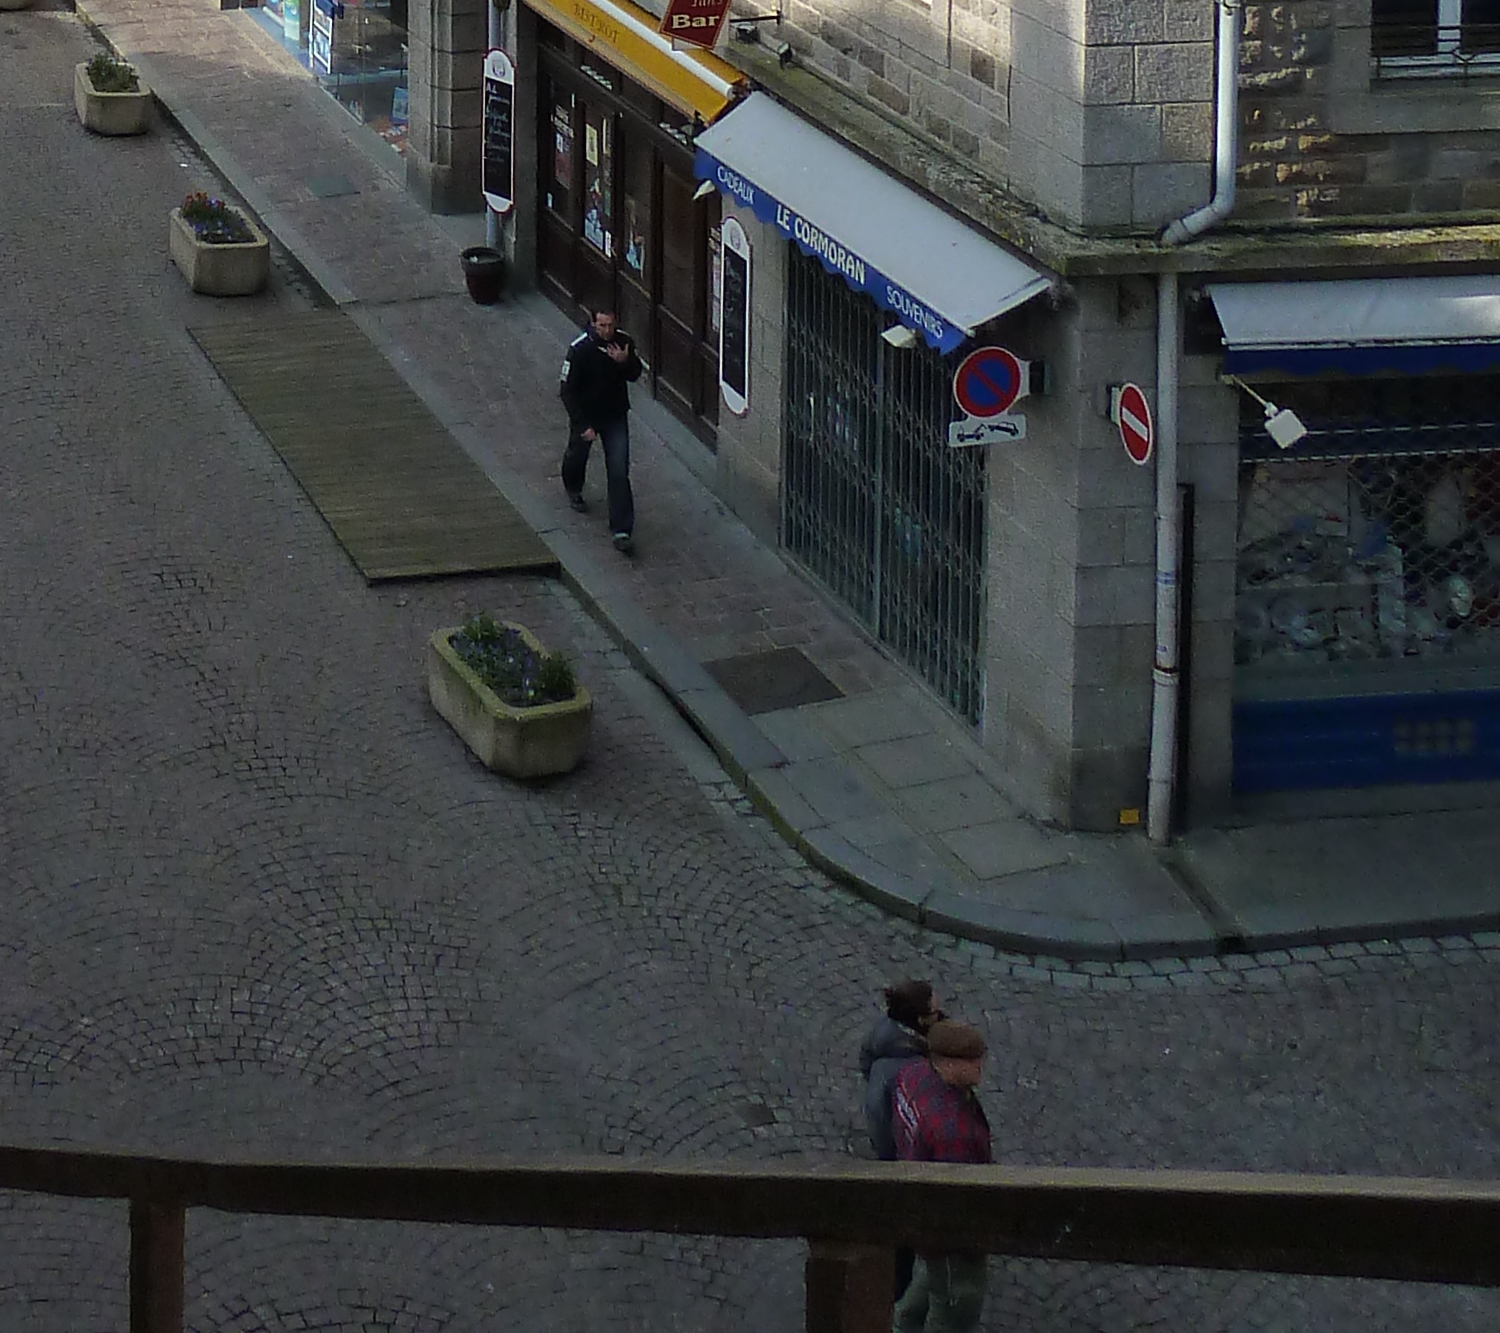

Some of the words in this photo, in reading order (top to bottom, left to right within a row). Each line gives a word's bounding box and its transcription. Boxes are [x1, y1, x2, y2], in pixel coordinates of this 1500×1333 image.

[672, 14, 720, 29] Bar
[717, 165, 755, 205] CADEAUX
[776, 204, 791, 231] LE
[794, 217, 865, 285] CORMORAN
[886, 284, 944, 339] SOUVENIRS
